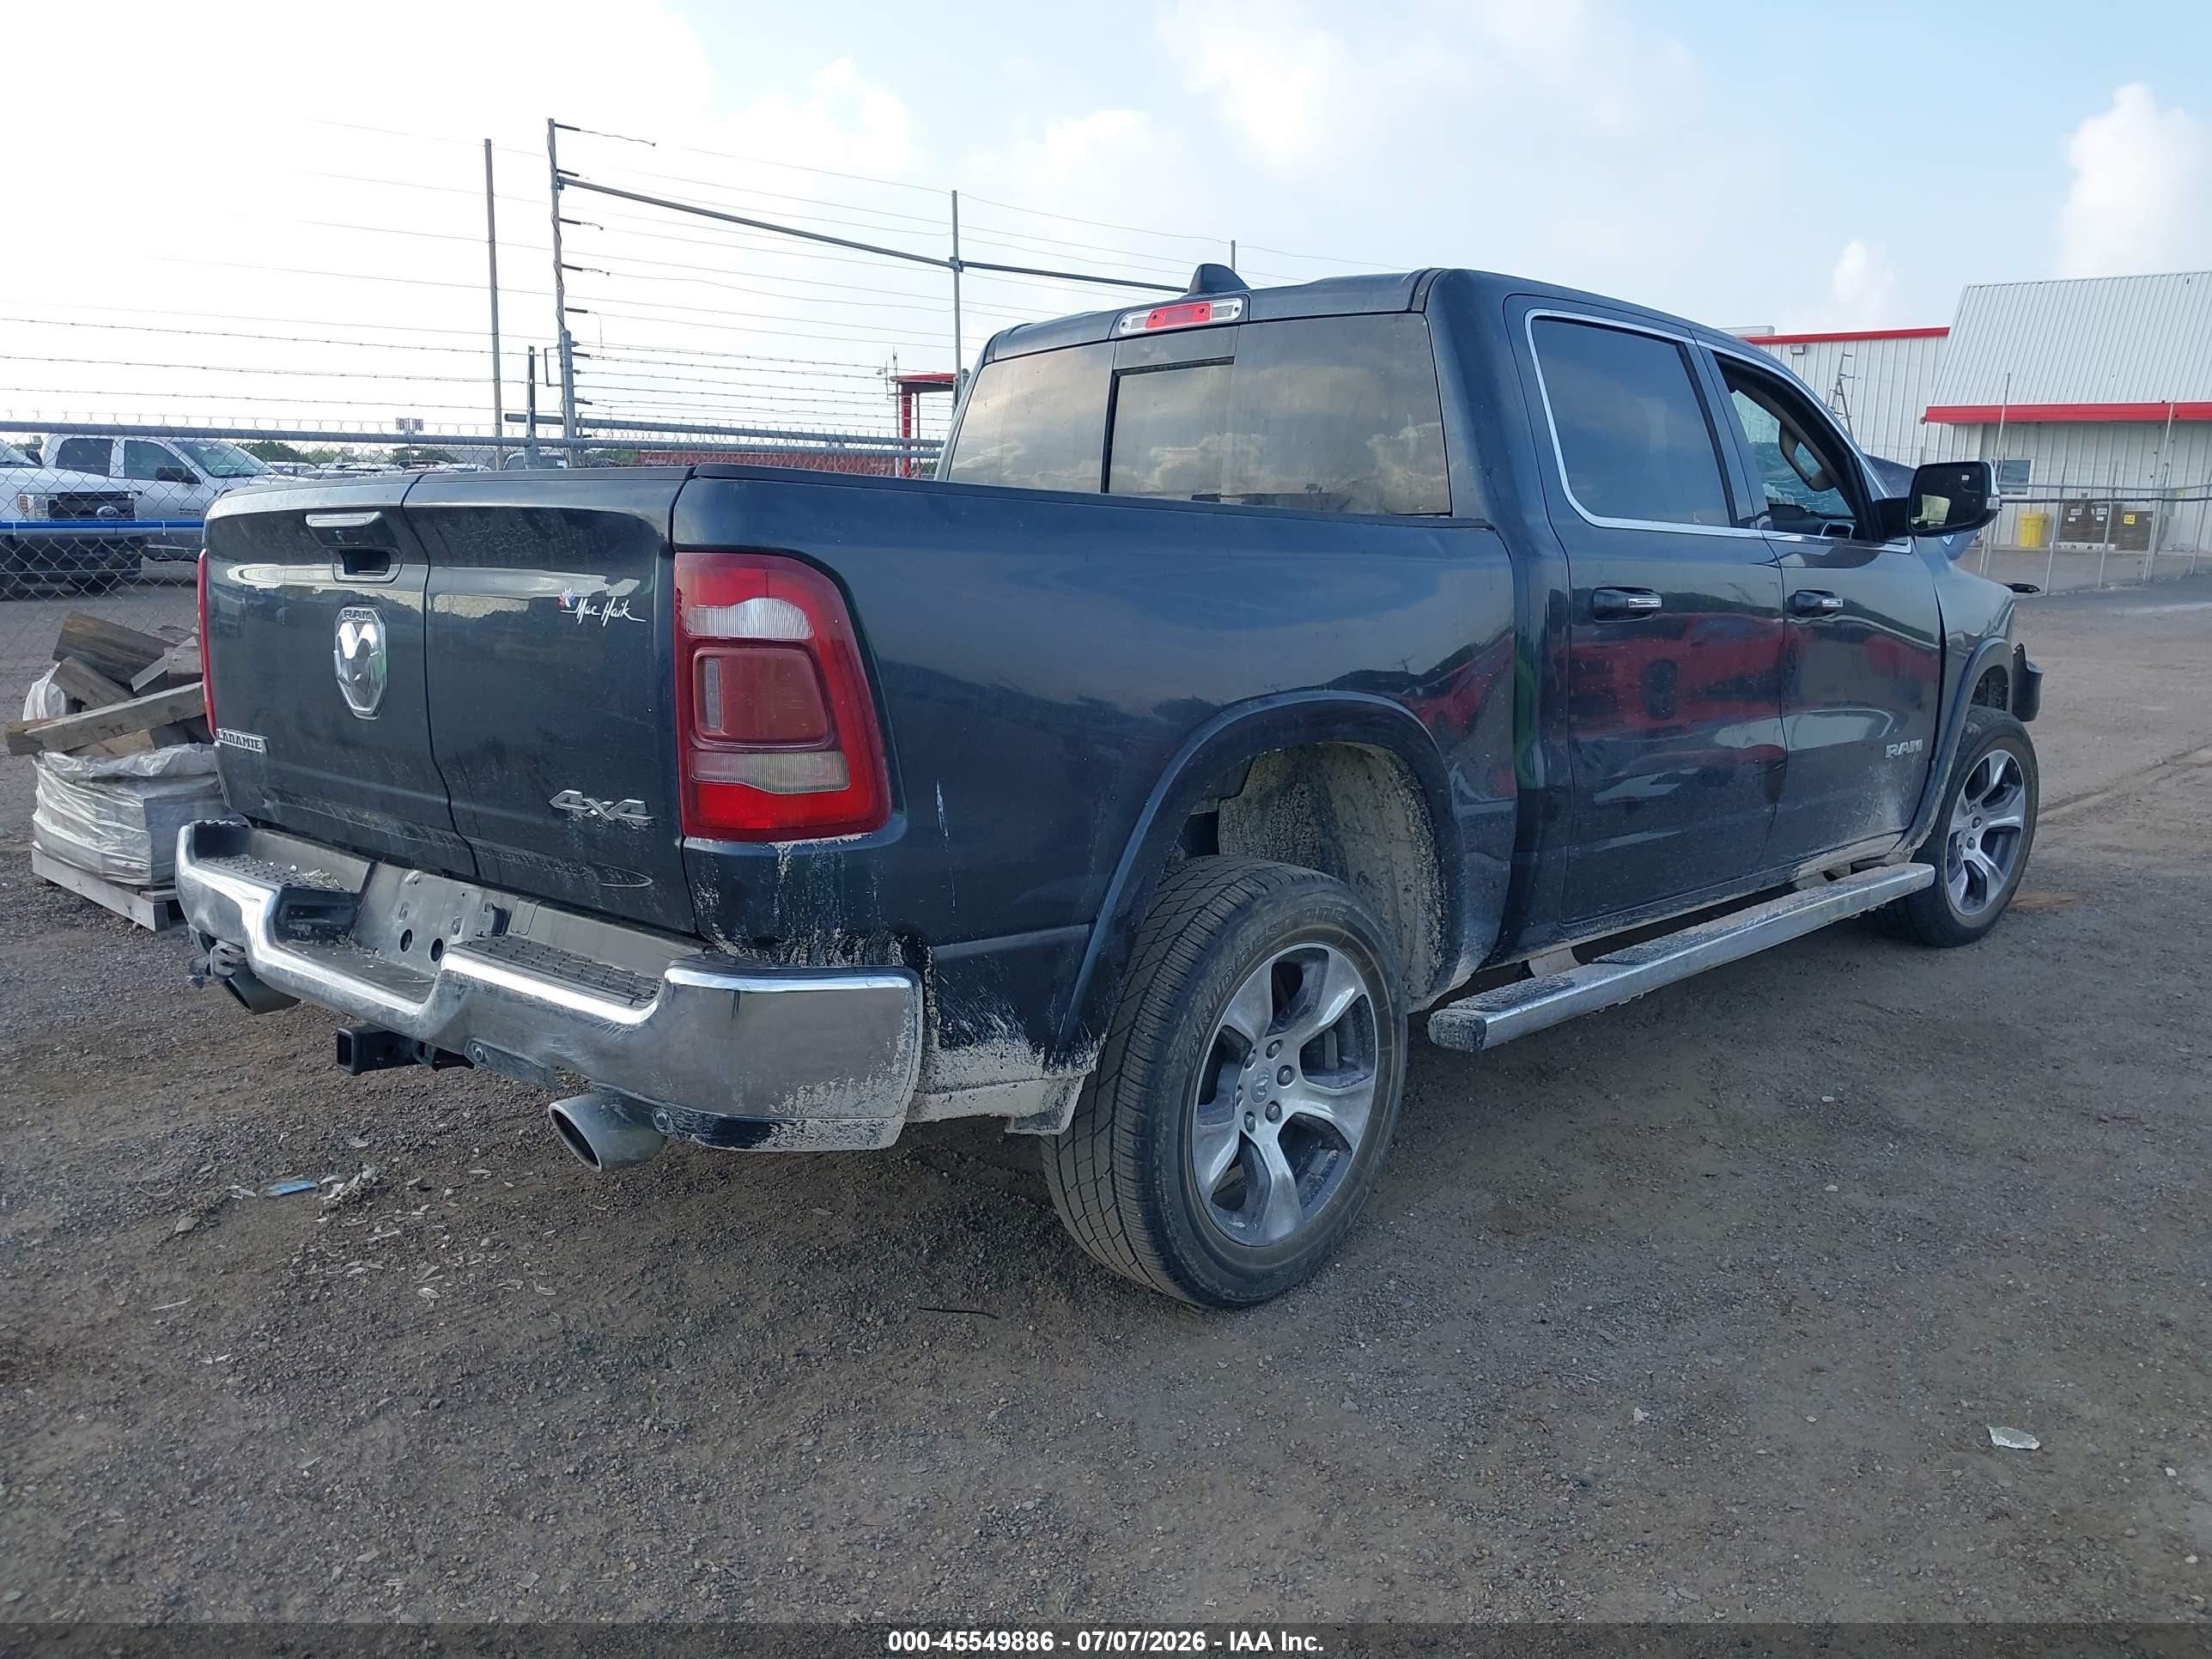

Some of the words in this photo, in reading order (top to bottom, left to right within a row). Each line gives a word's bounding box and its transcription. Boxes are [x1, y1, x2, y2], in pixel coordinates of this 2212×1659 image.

[343, 610, 372, 620] RAM
[559, 596, 601, 625] Mac
[600, 596, 647, 627] Haik
[216, 729, 263, 751] LARAMIE
[1884, 738, 1923, 758] RAM
